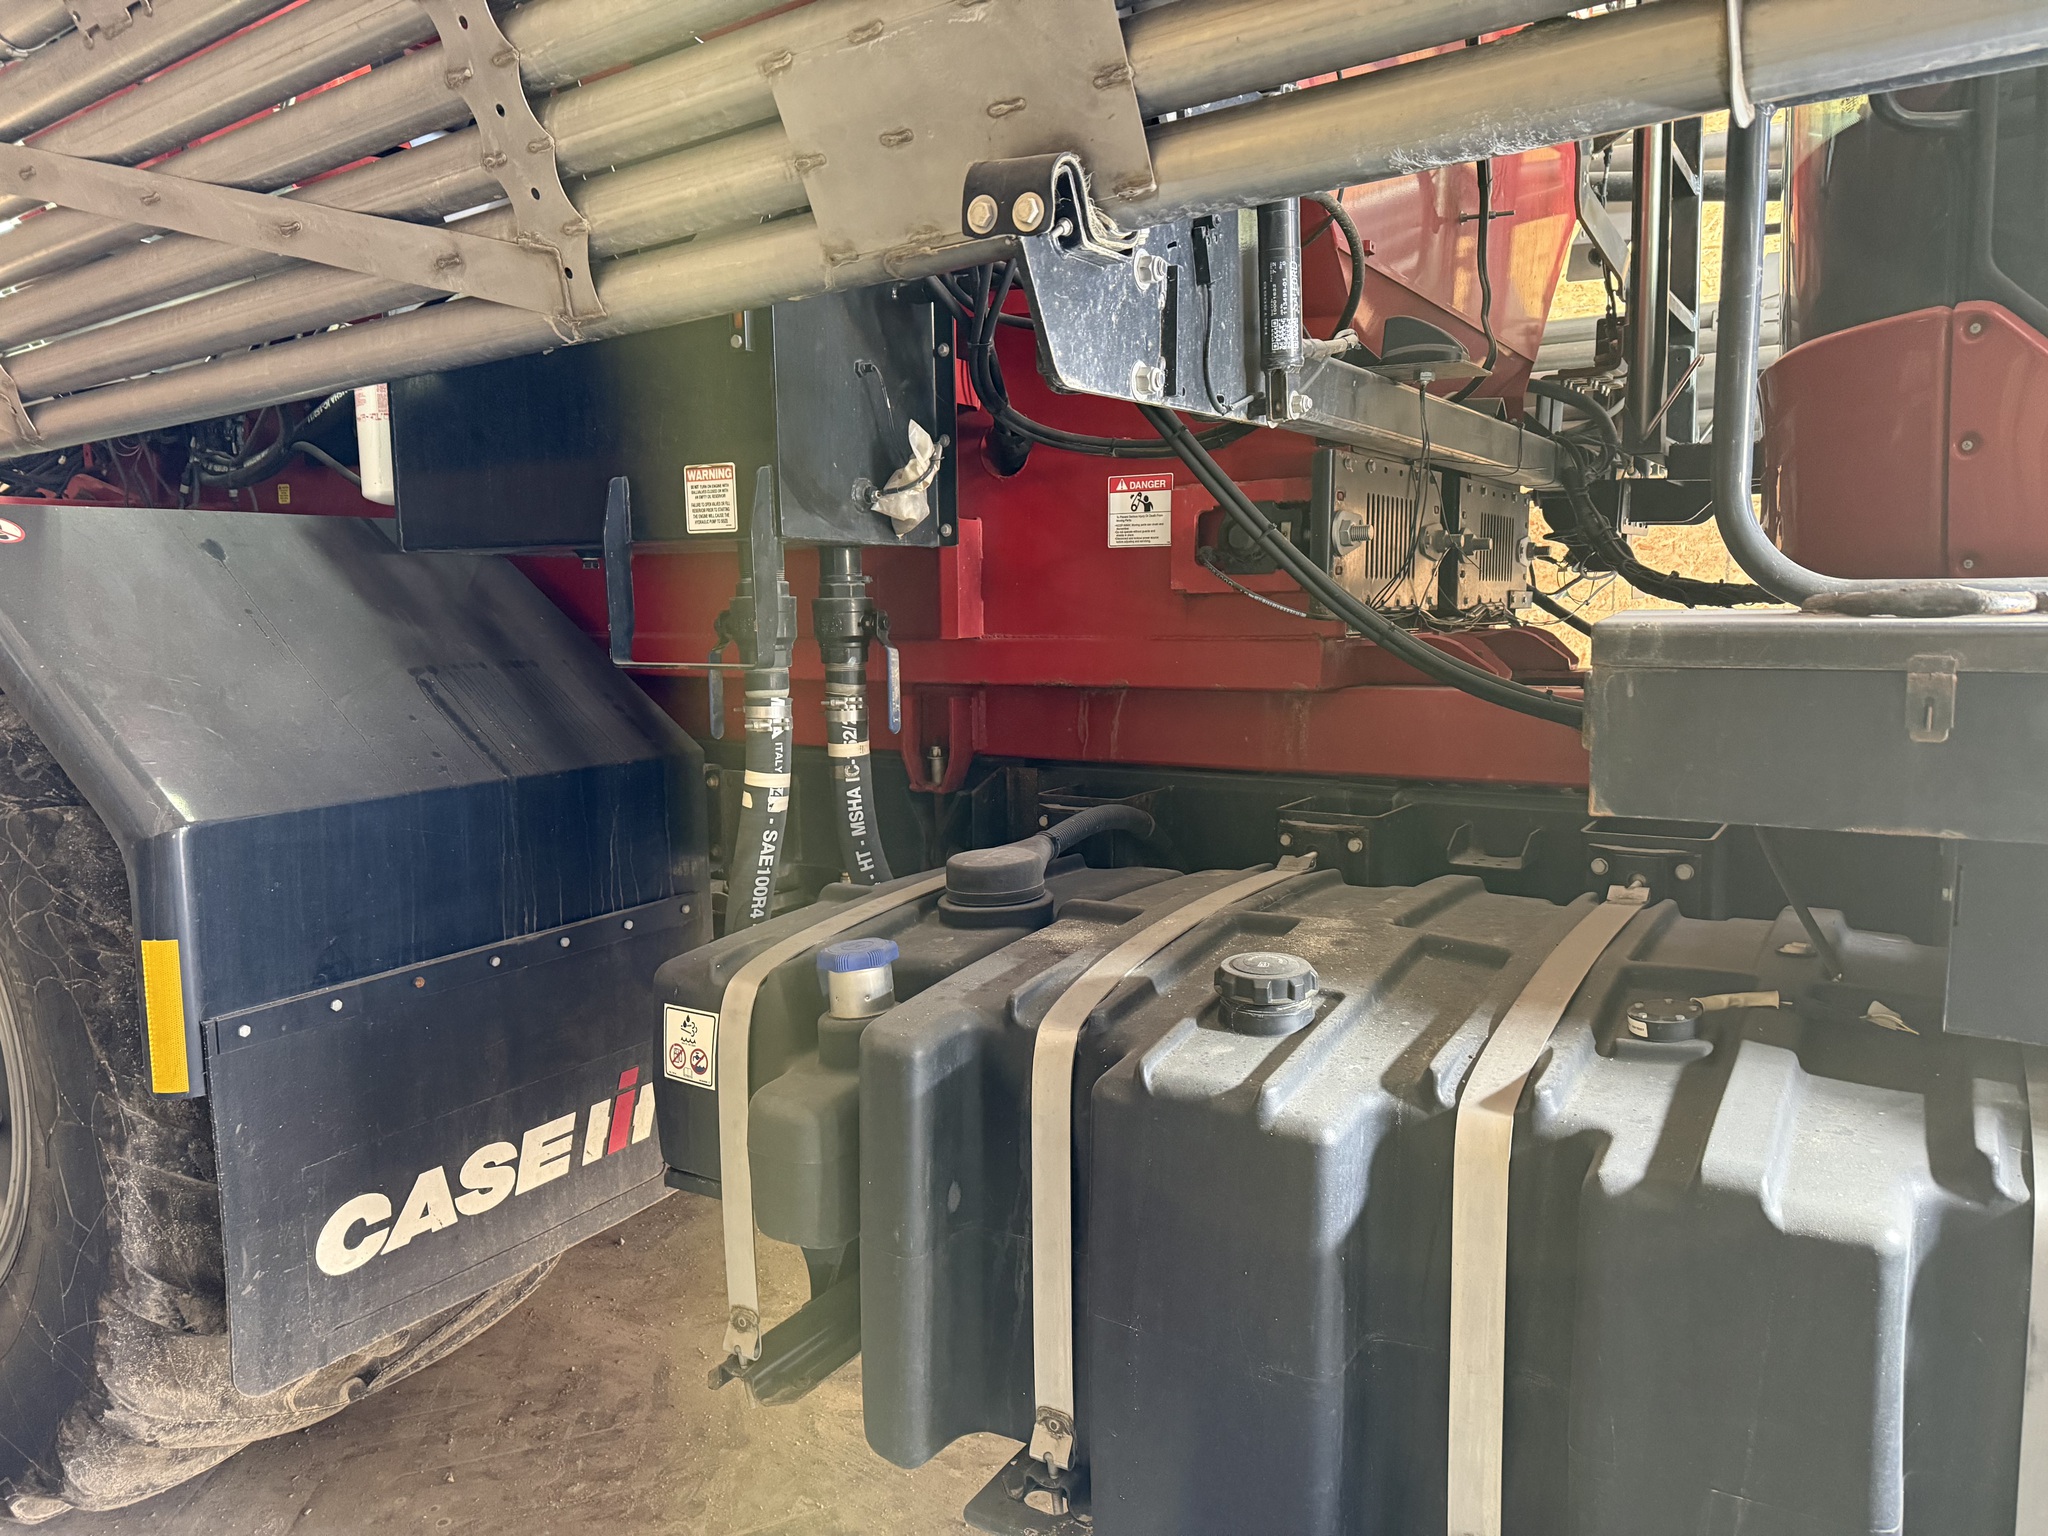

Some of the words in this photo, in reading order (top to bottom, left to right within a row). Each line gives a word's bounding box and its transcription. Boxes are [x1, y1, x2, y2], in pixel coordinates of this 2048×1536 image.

[687, 468, 732, 481] WARNING
[1130, 480, 1166, 489] DANGER
[774, 742, 783, 774] ITALY
[846, 786, 867, 836] MSHA
[750, 829, 778, 919] SAE100R4
[856, 850, 874, 872] HT
[315, 1111, 577, 1276] CASE
